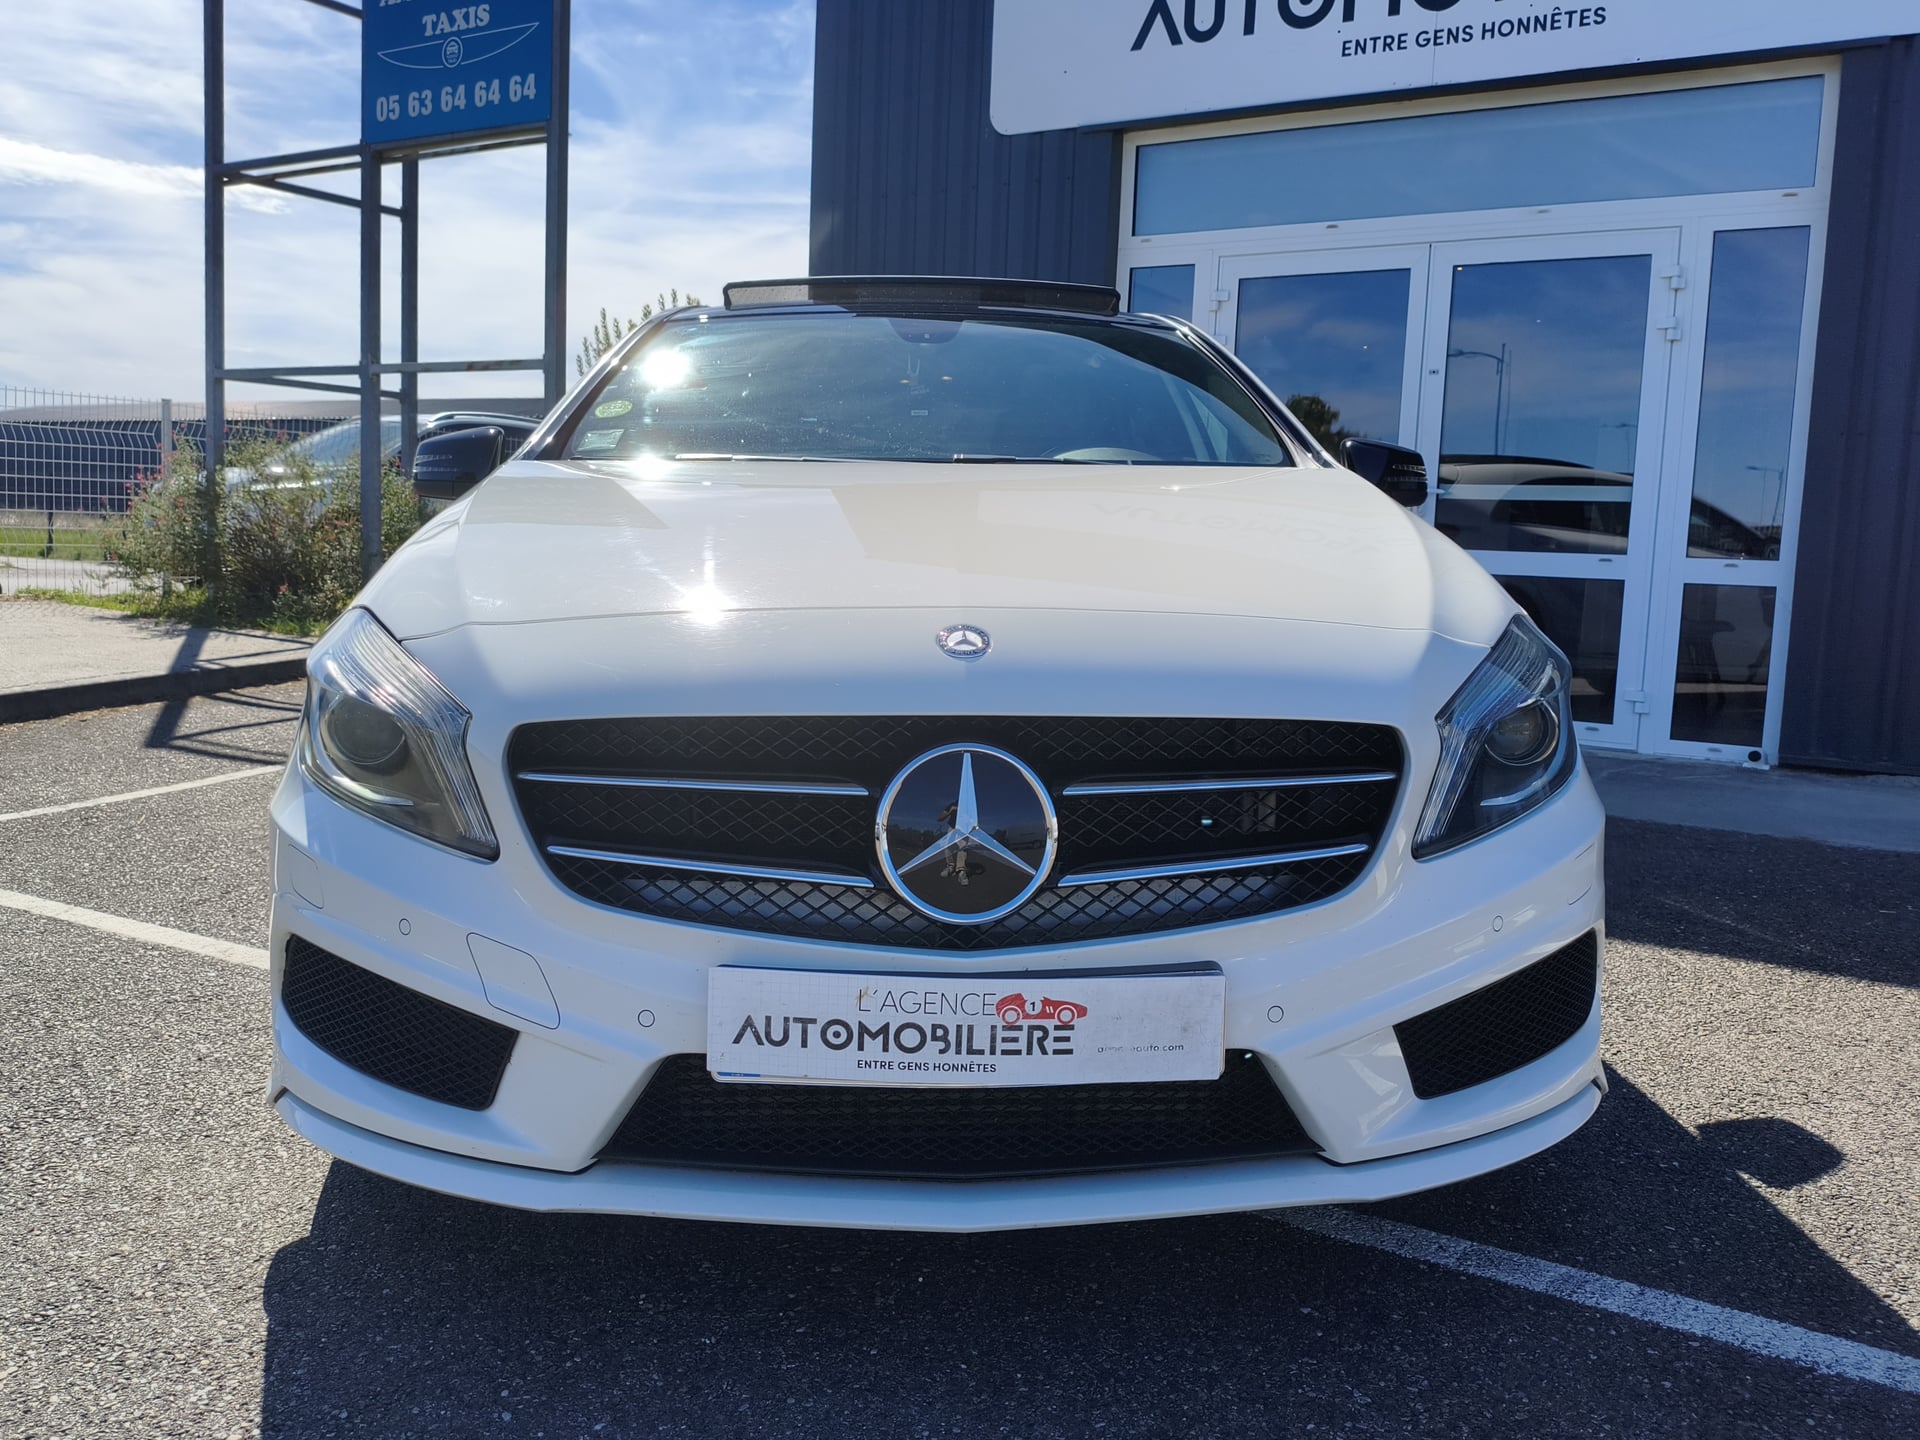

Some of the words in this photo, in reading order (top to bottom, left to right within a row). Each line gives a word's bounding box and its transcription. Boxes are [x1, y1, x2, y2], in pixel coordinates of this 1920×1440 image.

[422, 4, 491, 37] TAXIS
[1341, 33, 1408, 57] ENTRE
[1415, 25, 1474, 48] GENS
[1481, 6, 1607, 40] HONNÊTES
[376, 95, 400, 122] 05
[408, 89, 433, 117] 63
[440, 84, 467, 112] 64
[474, 79, 500, 107] 64
[509, 73, 536, 102] 64
[858, 988, 997, 1016] L'AGENCE
[857, 1059, 894, 1070] ENTRE
[897, 1061, 930, 1071] GENS
[933, 1061, 997, 1073] HONNÊTES
